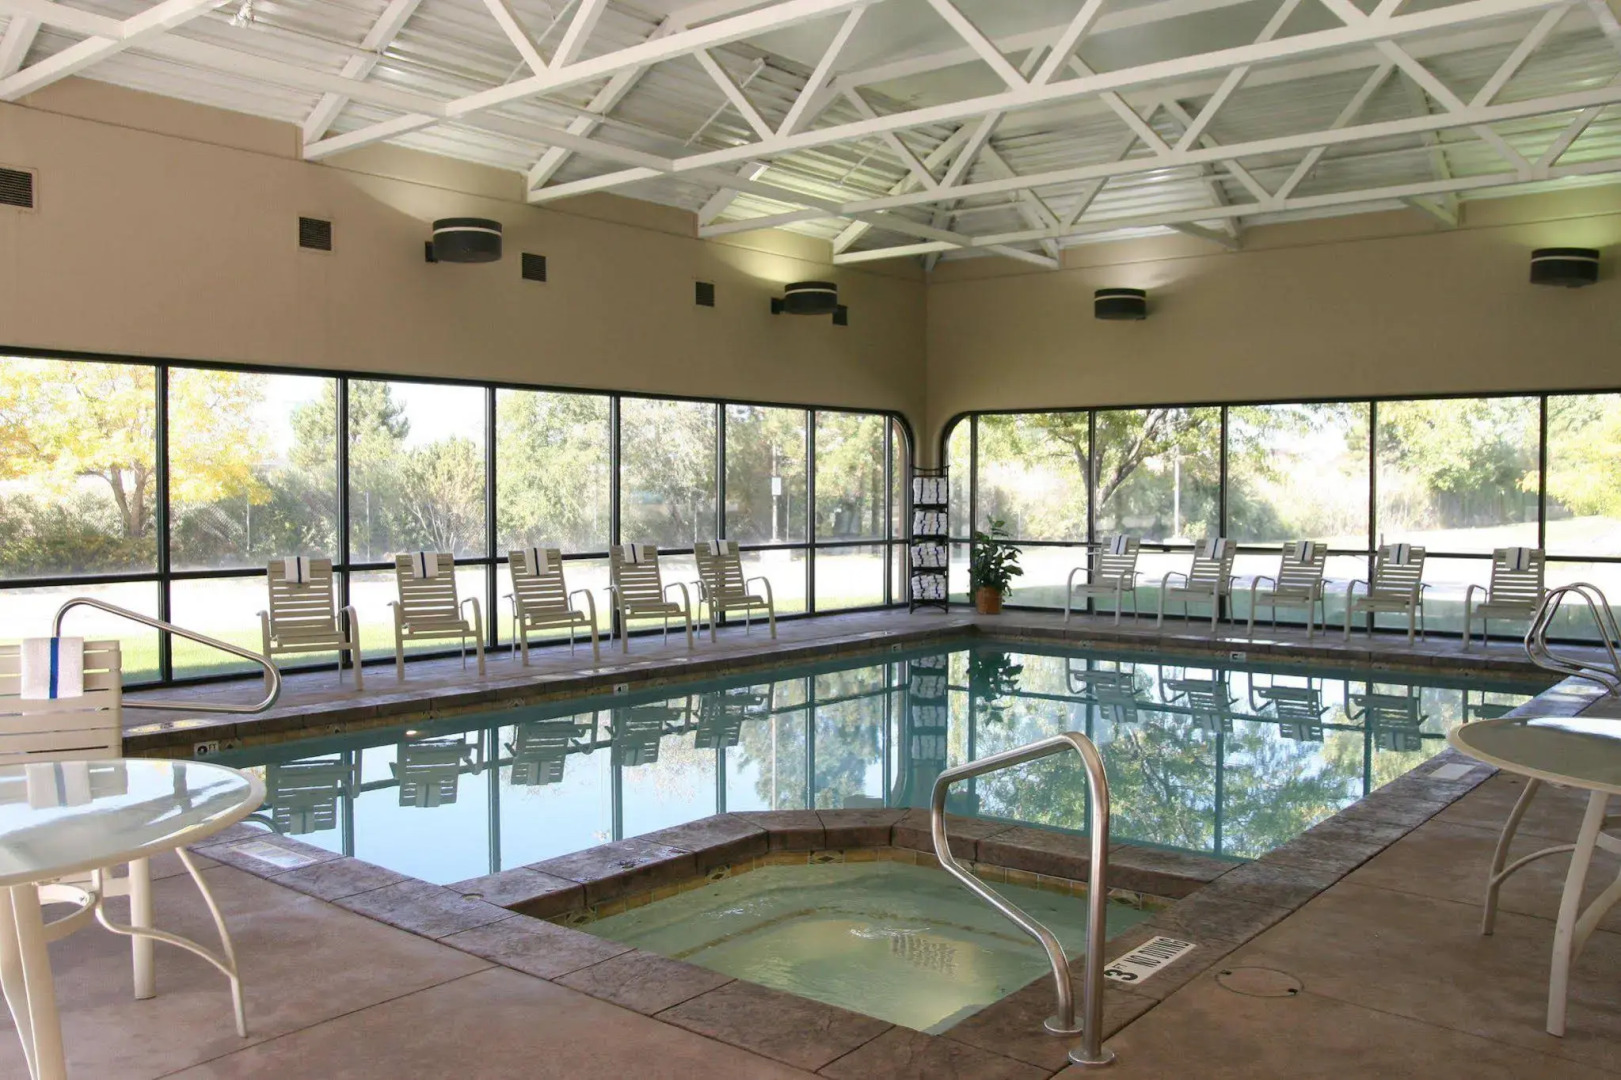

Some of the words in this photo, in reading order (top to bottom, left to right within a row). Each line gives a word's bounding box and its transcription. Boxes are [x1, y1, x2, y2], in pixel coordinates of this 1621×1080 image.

[1138, 938, 1190, 960] DIVING
[1123, 955, 1161, 968] NO
[1104, 969, 1138, 981] 3
